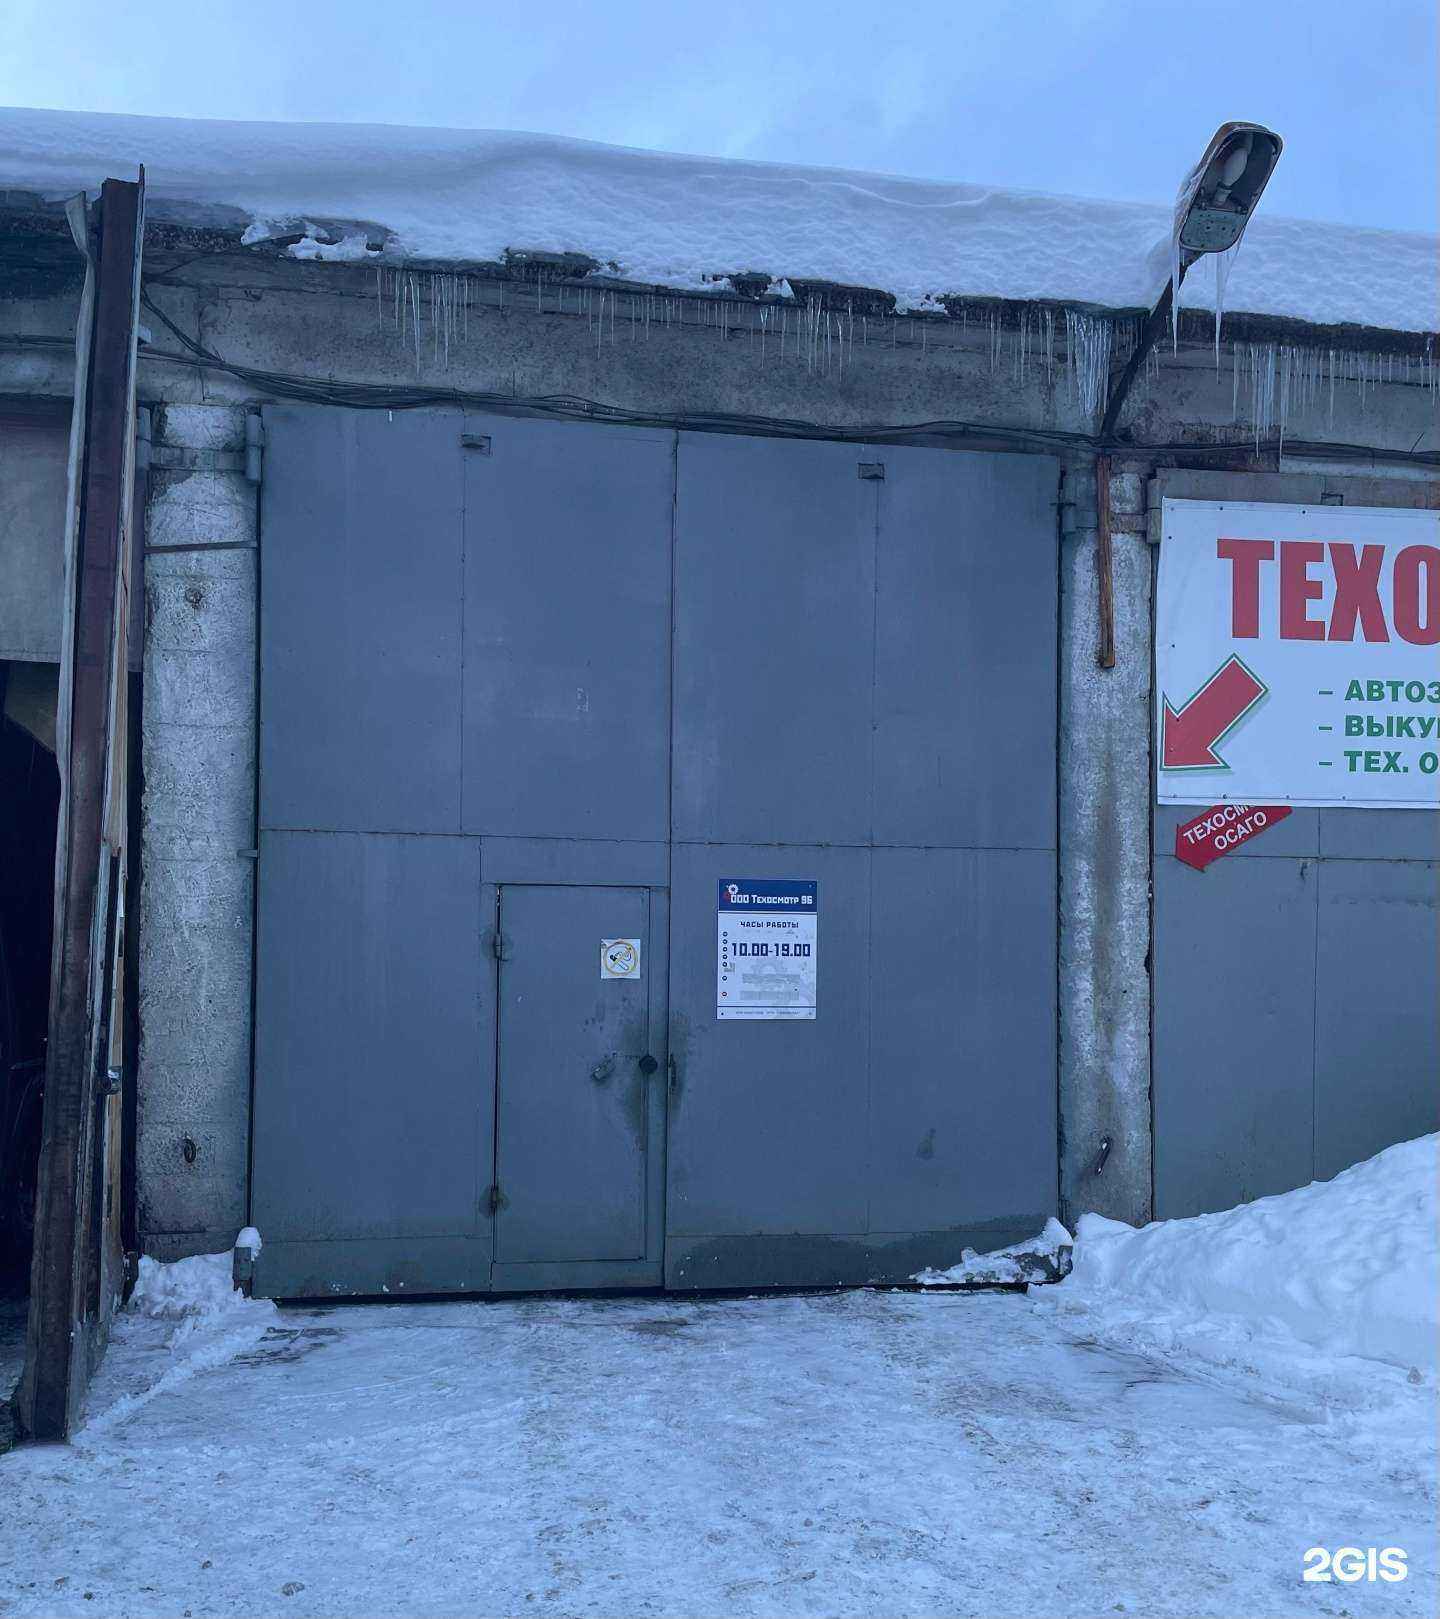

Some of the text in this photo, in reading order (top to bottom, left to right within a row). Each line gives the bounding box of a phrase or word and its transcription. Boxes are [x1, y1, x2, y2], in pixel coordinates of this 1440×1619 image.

[1216, 537, 1440, 646] ТЕХО
[1344, 679, 1440, 704] АВТОЗ
[1344, 714, 1440, 739] ВЫКУ
[1343, 750, 1409, 774] ТЕХ.
[1183, 804, 1256, 845] ТЕХОСМ
[1214, 811, 1267, 850] ОСАГО
[730, 894, 750, 904] ООО
[766, 921, 799, 929] РАБОТЫ
[731, 942, 811, 957] 10.00-19.00
